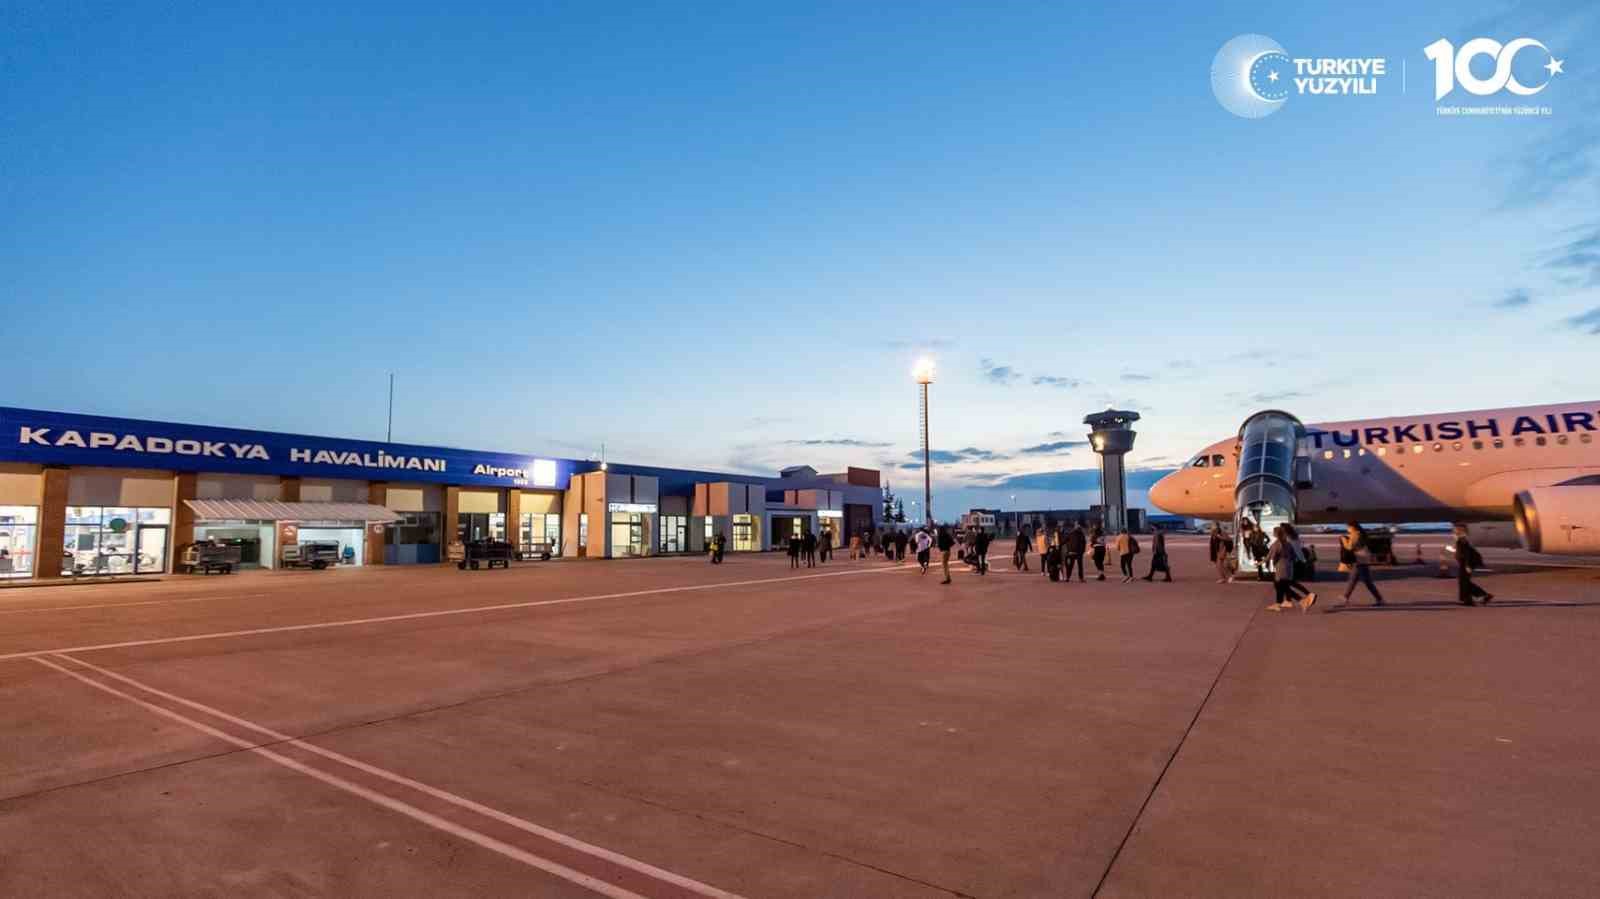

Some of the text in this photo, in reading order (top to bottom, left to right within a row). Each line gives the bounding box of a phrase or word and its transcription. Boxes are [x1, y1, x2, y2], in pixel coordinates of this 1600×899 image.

[1304, 411, 1600, 449] TURKISH AIR
[19, 426, 447, 473] KAPADOKYA HAVALİMANI
[473, 463, 529, 478] Airport
